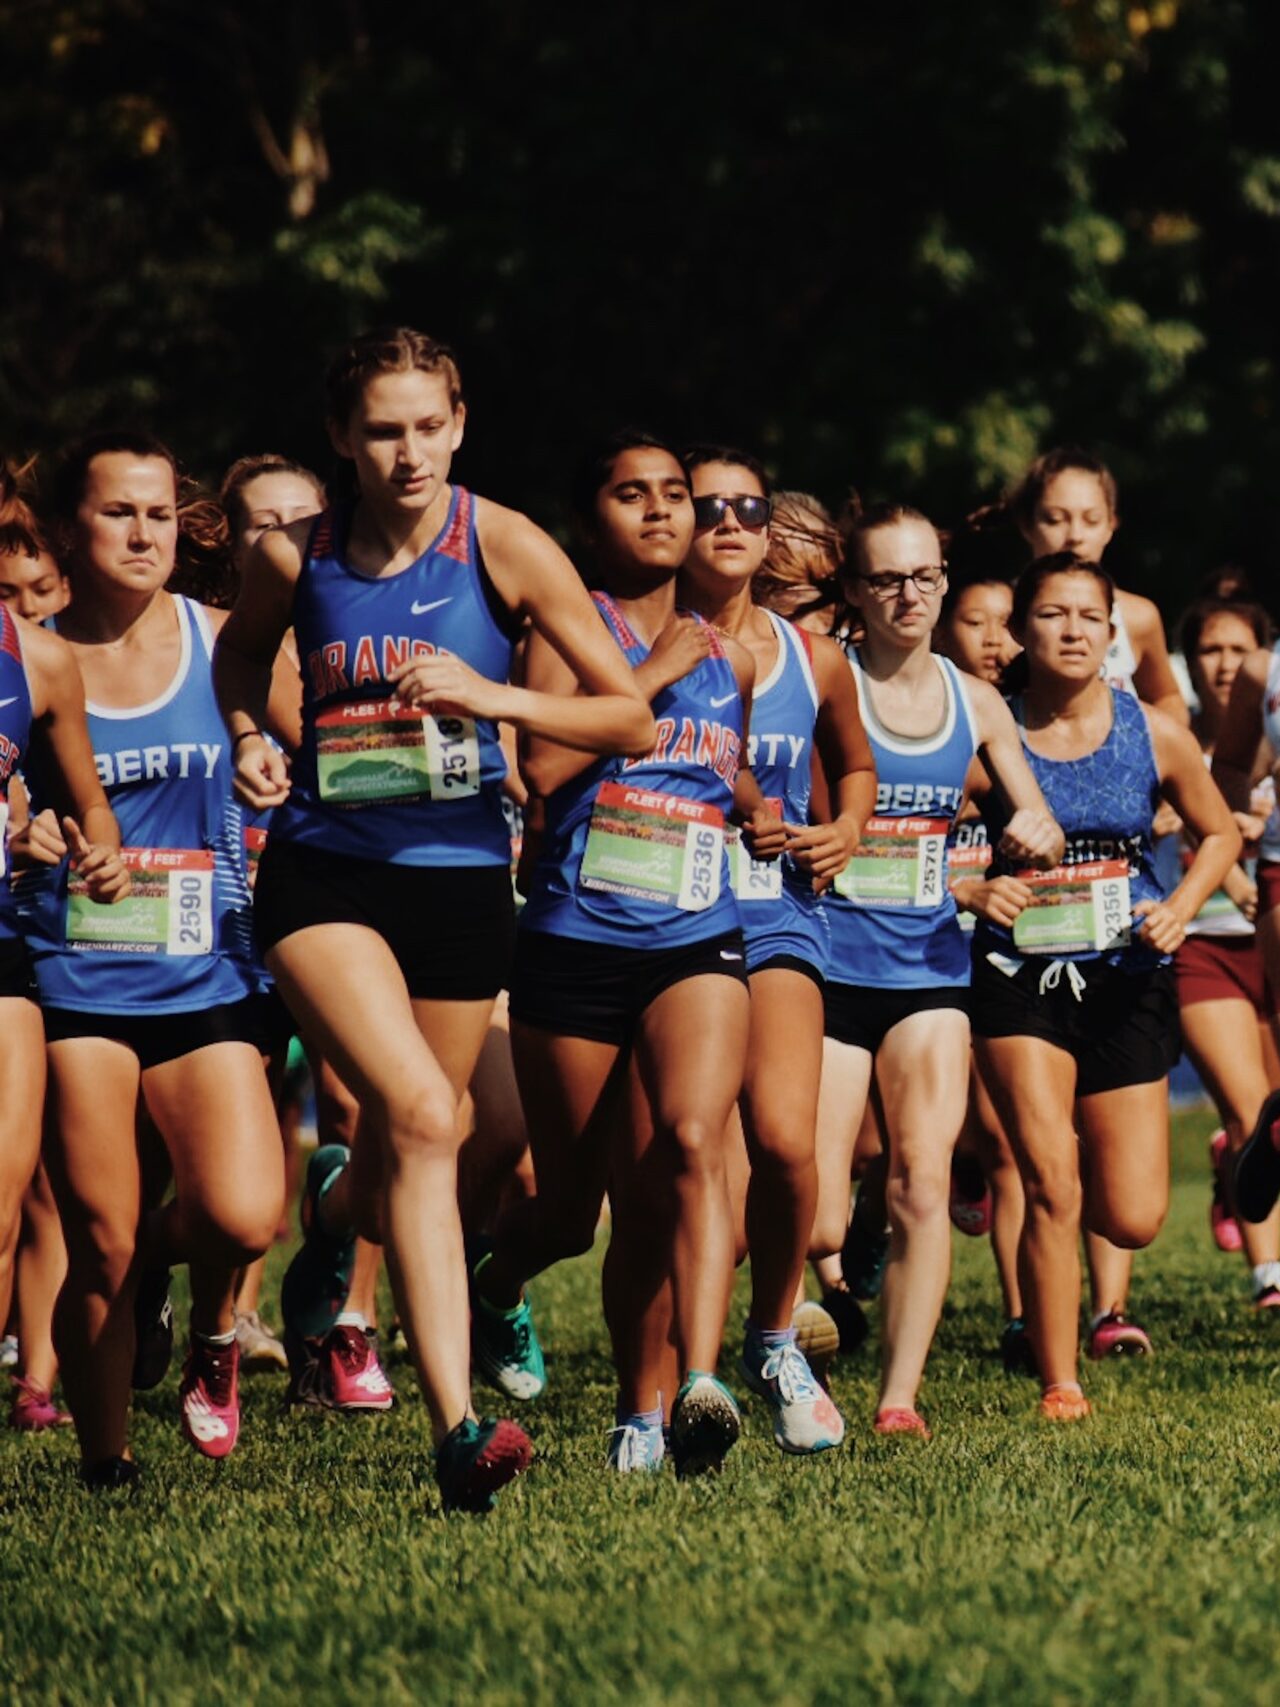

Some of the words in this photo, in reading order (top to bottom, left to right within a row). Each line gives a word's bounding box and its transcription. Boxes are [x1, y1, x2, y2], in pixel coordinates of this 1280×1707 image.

[308, 634, 454, 700] ORAN
[437, 718, 470, 789] 2518
[624, 792, 665, 811] FLEET
[676, 803, 705, 818] FEET
[153, 854, 185, 866] FEET
[691, 831, 716, 901] 2536
[921, 839, 939, 896] 2570
[179, 876, 201, 944] 2590
[1102, 883, 1122, 939] 2356
